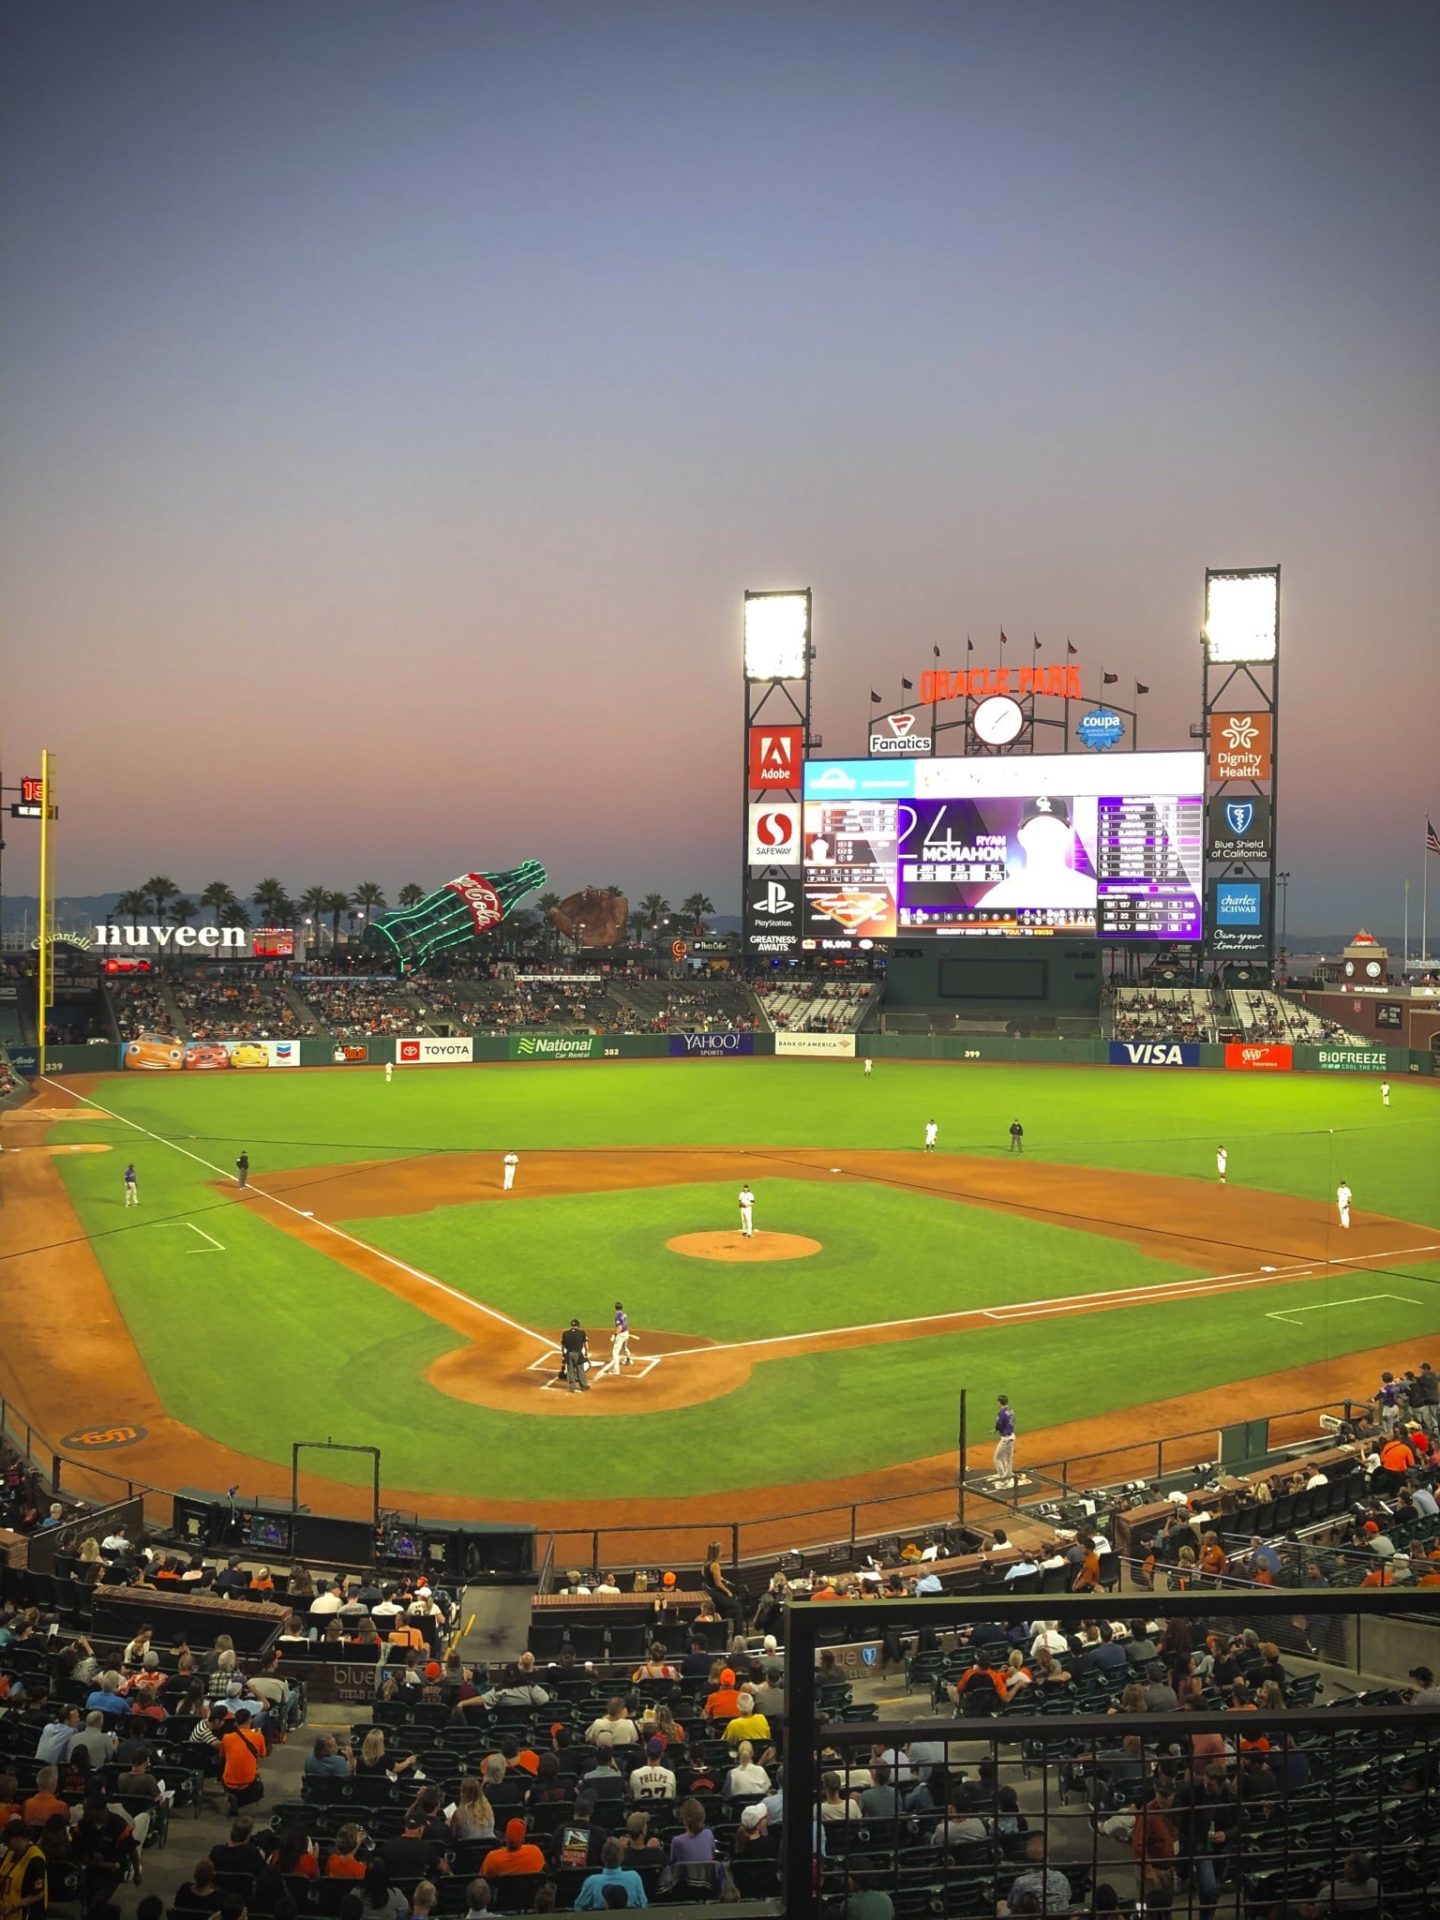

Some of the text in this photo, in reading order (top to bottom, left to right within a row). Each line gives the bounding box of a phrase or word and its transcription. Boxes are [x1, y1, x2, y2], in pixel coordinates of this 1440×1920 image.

[921, 665, 1082, 704] ORACLE PARK
[1083, 716, 1120, 728] coupa
[872, 737, 931, 750] Fanatics
[1218, 753, 1261, 766] Dignity
[761, 768, 790, 779] Adobe
[976, 836, 1006, 846] RYAN
[1214, 840, 1264, 849] Blue Shield
[756, 847, 792, 855] SAFEWAY
[923, 847, 1007, 862] MCMAHON
[1211, 849, 1268, 858] of California
[1221, 895, 1256, 905] charles
[754, 920, 792, 928] PlayStation
[95, 925, 247, 946] nuveen
[535, 1038, 593, 1052] National
[684, 1034, 740, 1050] YAHOO!
[425, 1046, 470, 1055] TOYOTA
[1123, 1044, 1183, 1065] VISA
[45, 1063, 63, 1071] 339
[334, 1666, 376, 1685] blue
[639, 1771, 668, 1785] PHELPS
